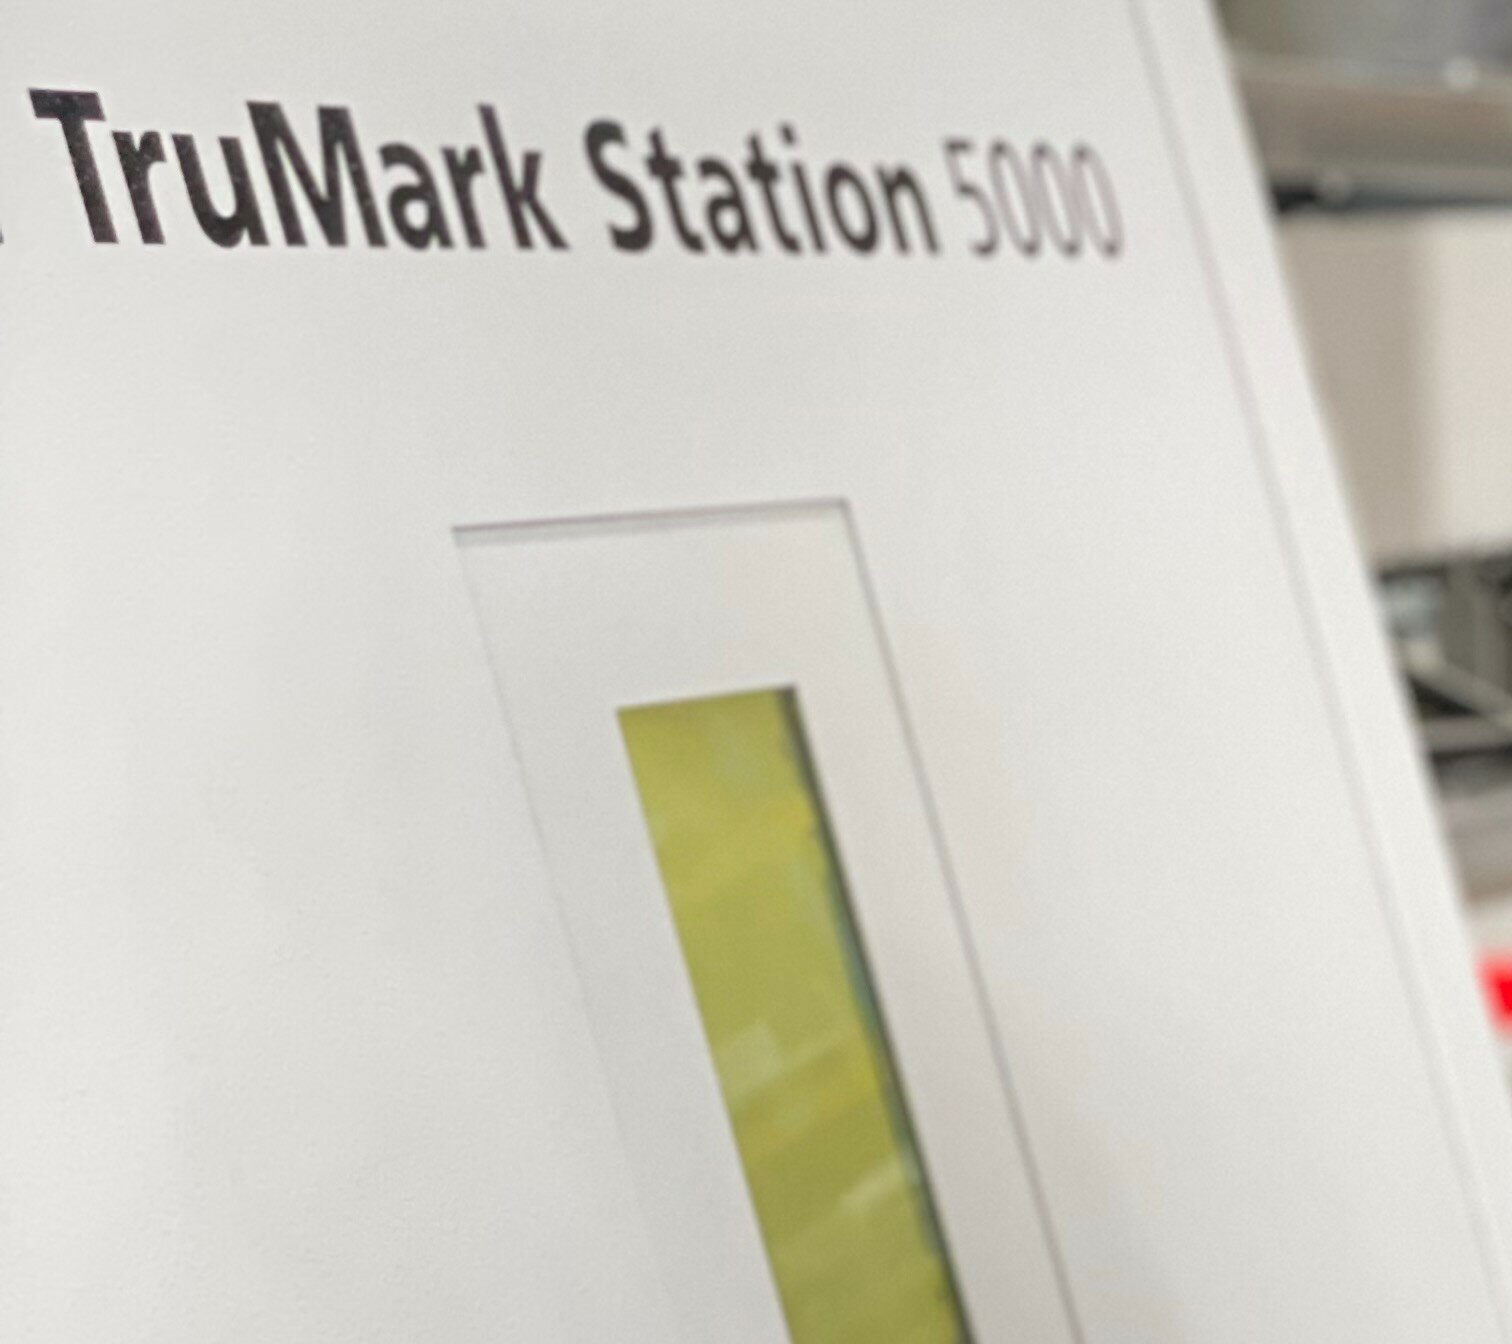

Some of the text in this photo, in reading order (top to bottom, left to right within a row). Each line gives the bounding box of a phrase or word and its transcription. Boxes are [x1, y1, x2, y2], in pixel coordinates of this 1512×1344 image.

[27, 88, 1122, 258] TruMark Station 5000
